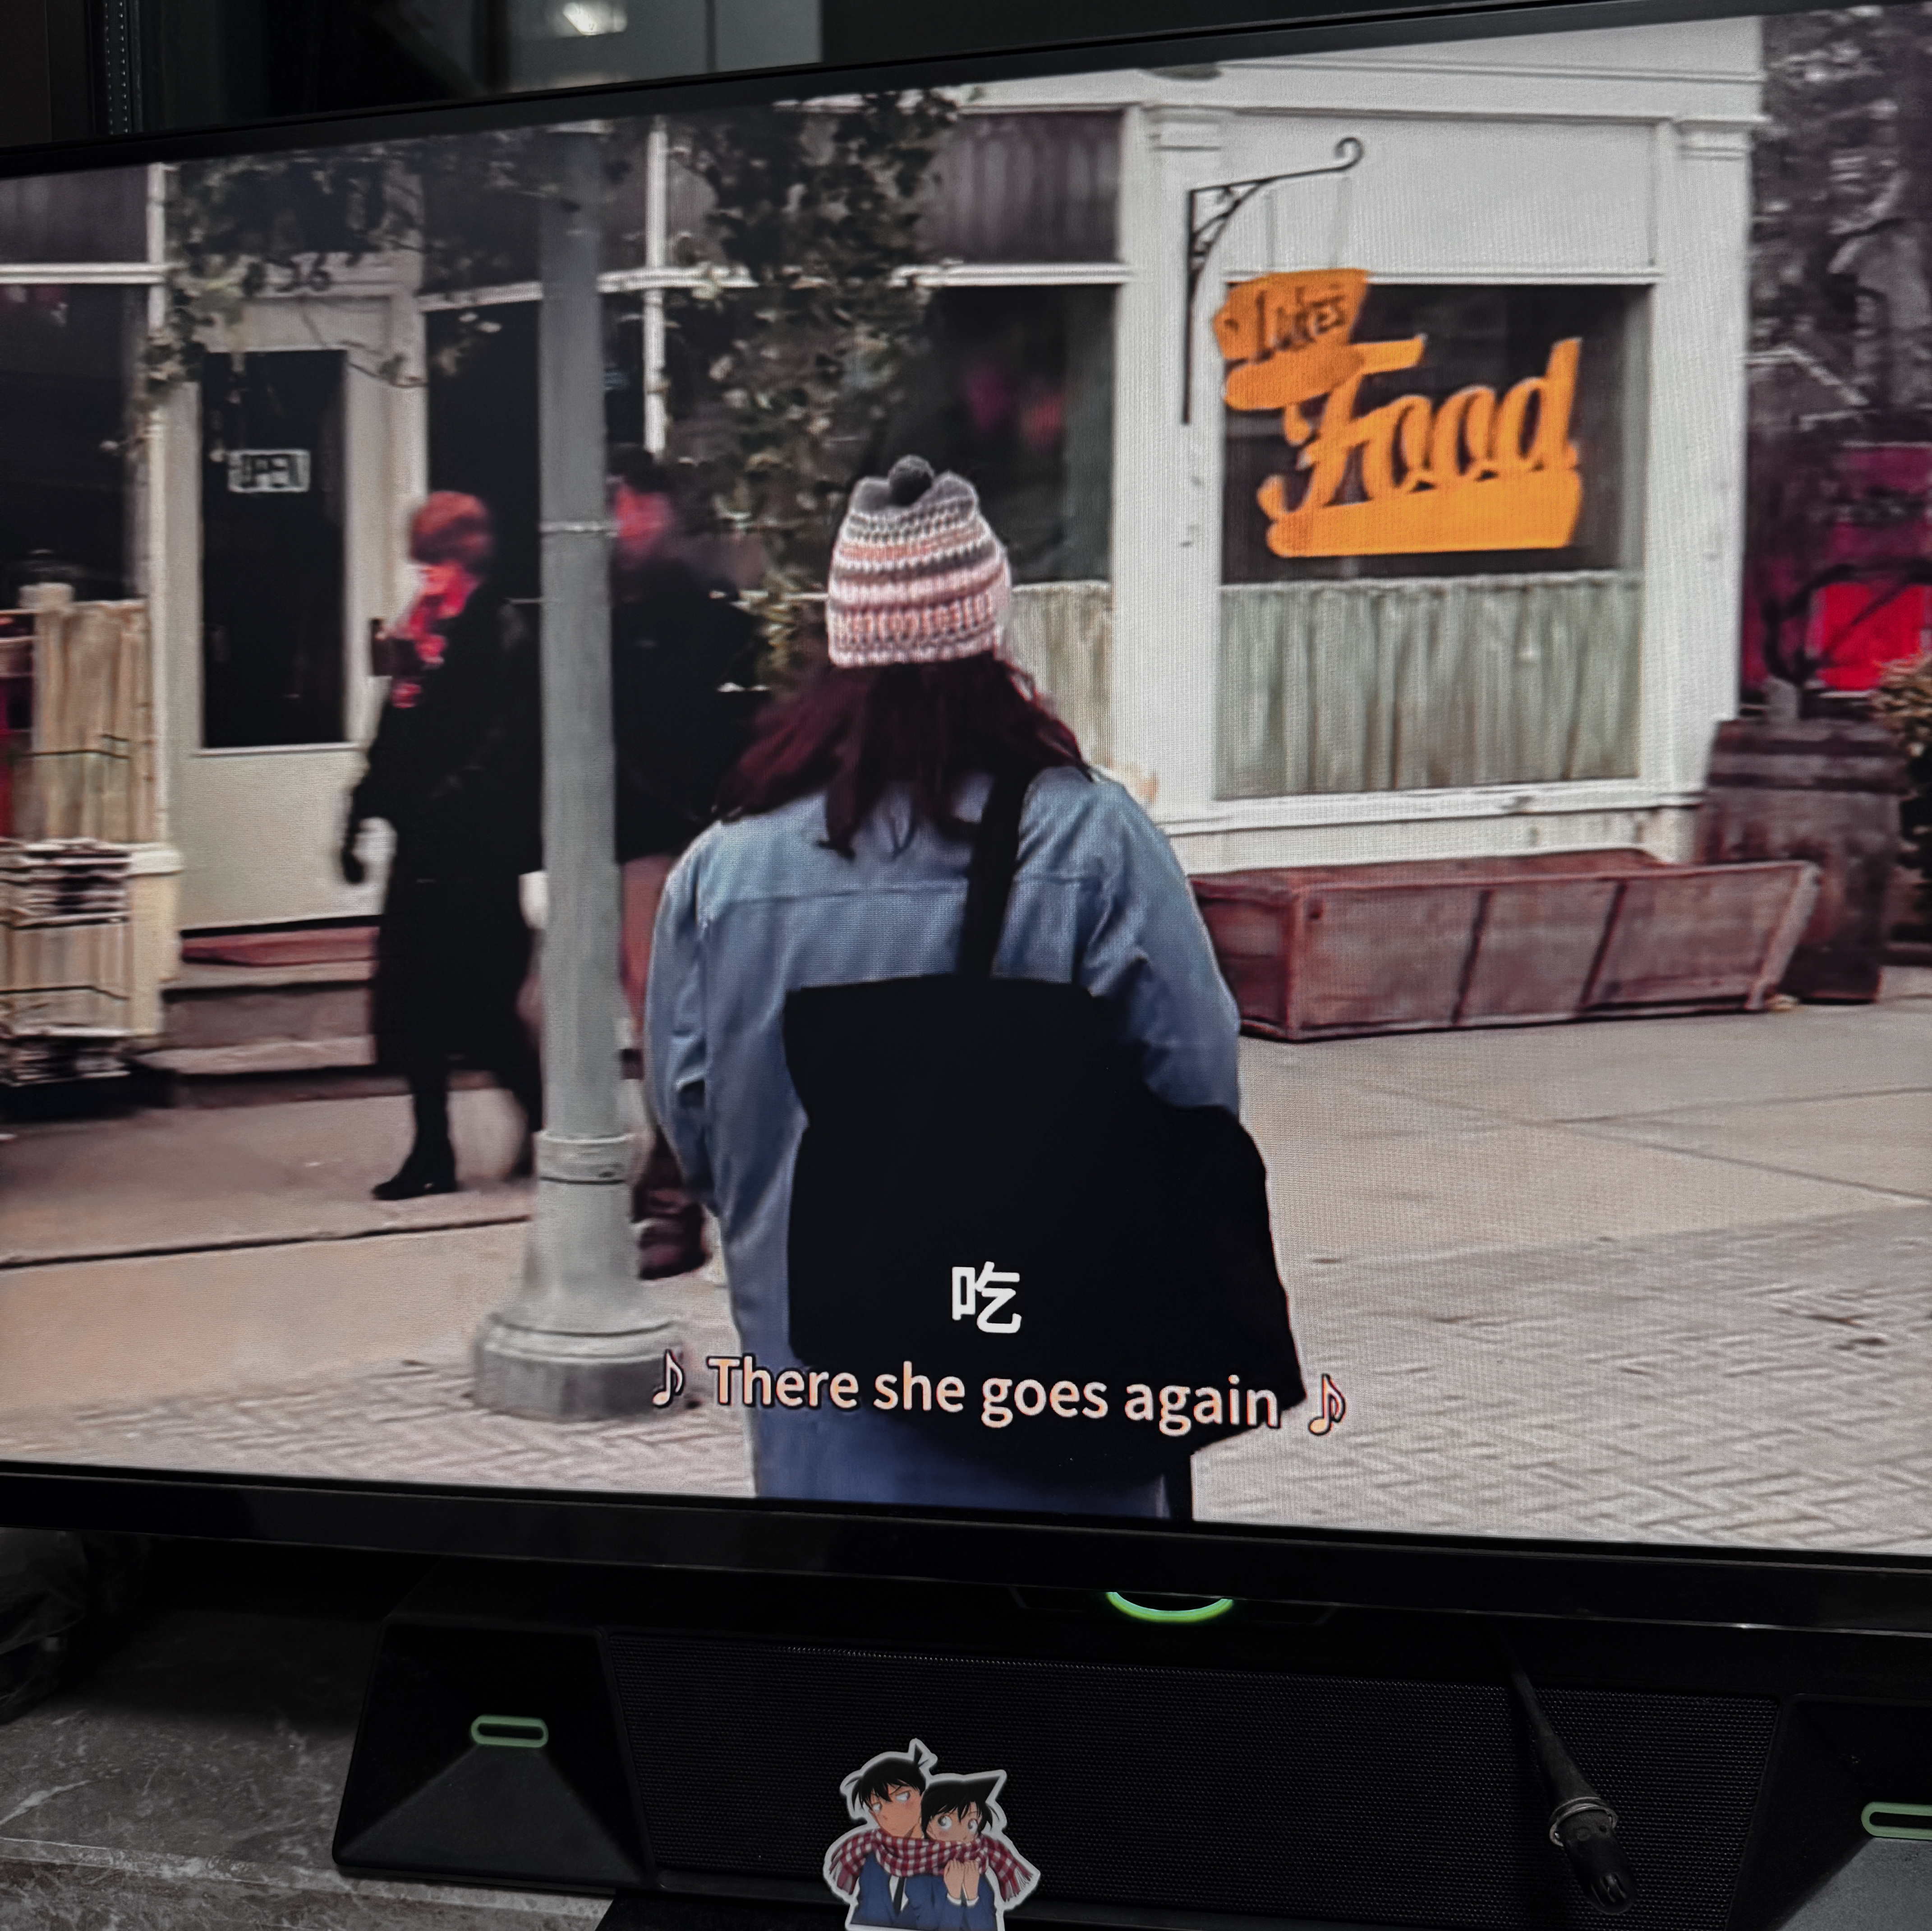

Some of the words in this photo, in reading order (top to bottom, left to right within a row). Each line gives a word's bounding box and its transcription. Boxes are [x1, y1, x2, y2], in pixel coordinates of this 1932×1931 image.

[1257, 335, 1583, 523] Food
[951, 1261, 1022, 1334] 吃
[707, 1355, 859, 1409] There
[873, 1360, 966, 1413] she
[980, 1377, 1109, 1429] goes
[1124, 1373, 1279, 1437] again
